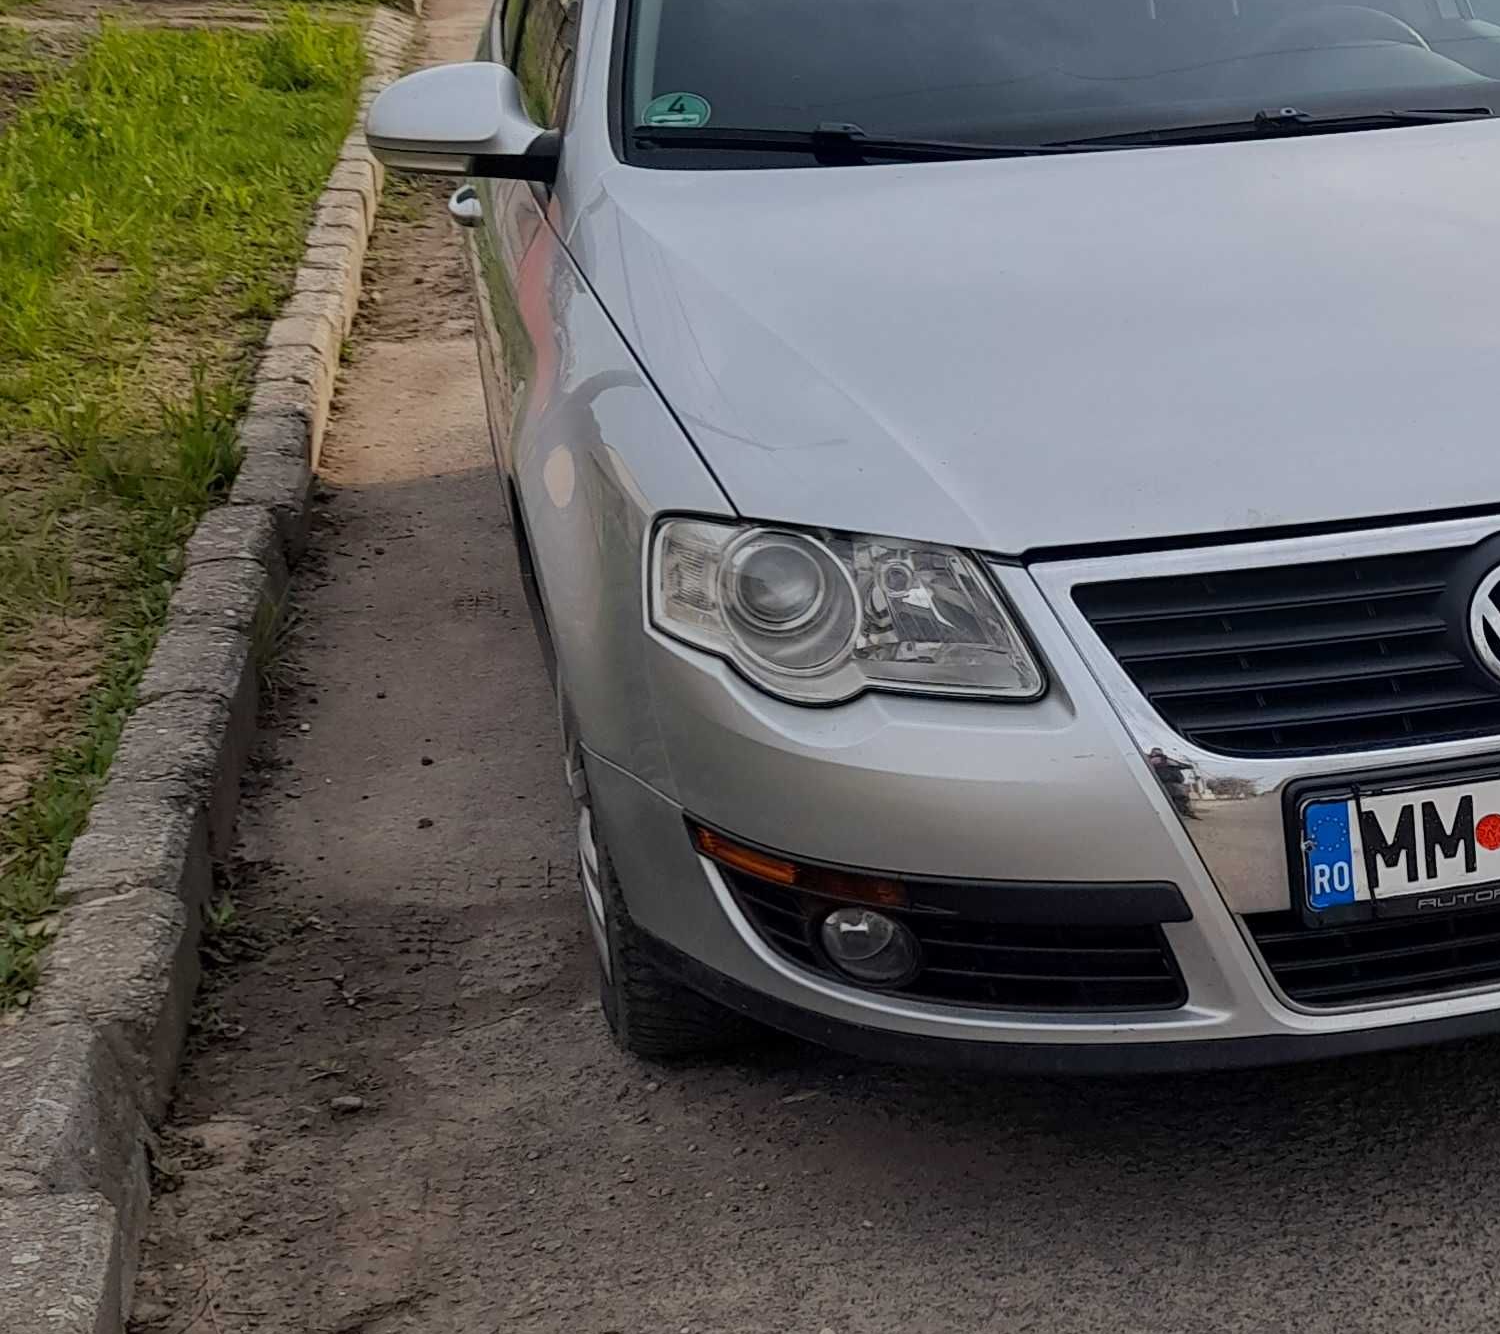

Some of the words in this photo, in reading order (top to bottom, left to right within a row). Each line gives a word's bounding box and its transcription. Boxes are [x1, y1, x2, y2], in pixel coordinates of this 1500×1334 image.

[668, 95, 686, 114] 4
[1361, 794, 1477, 889] MM
[1313, 860, 1351, 895] RO
